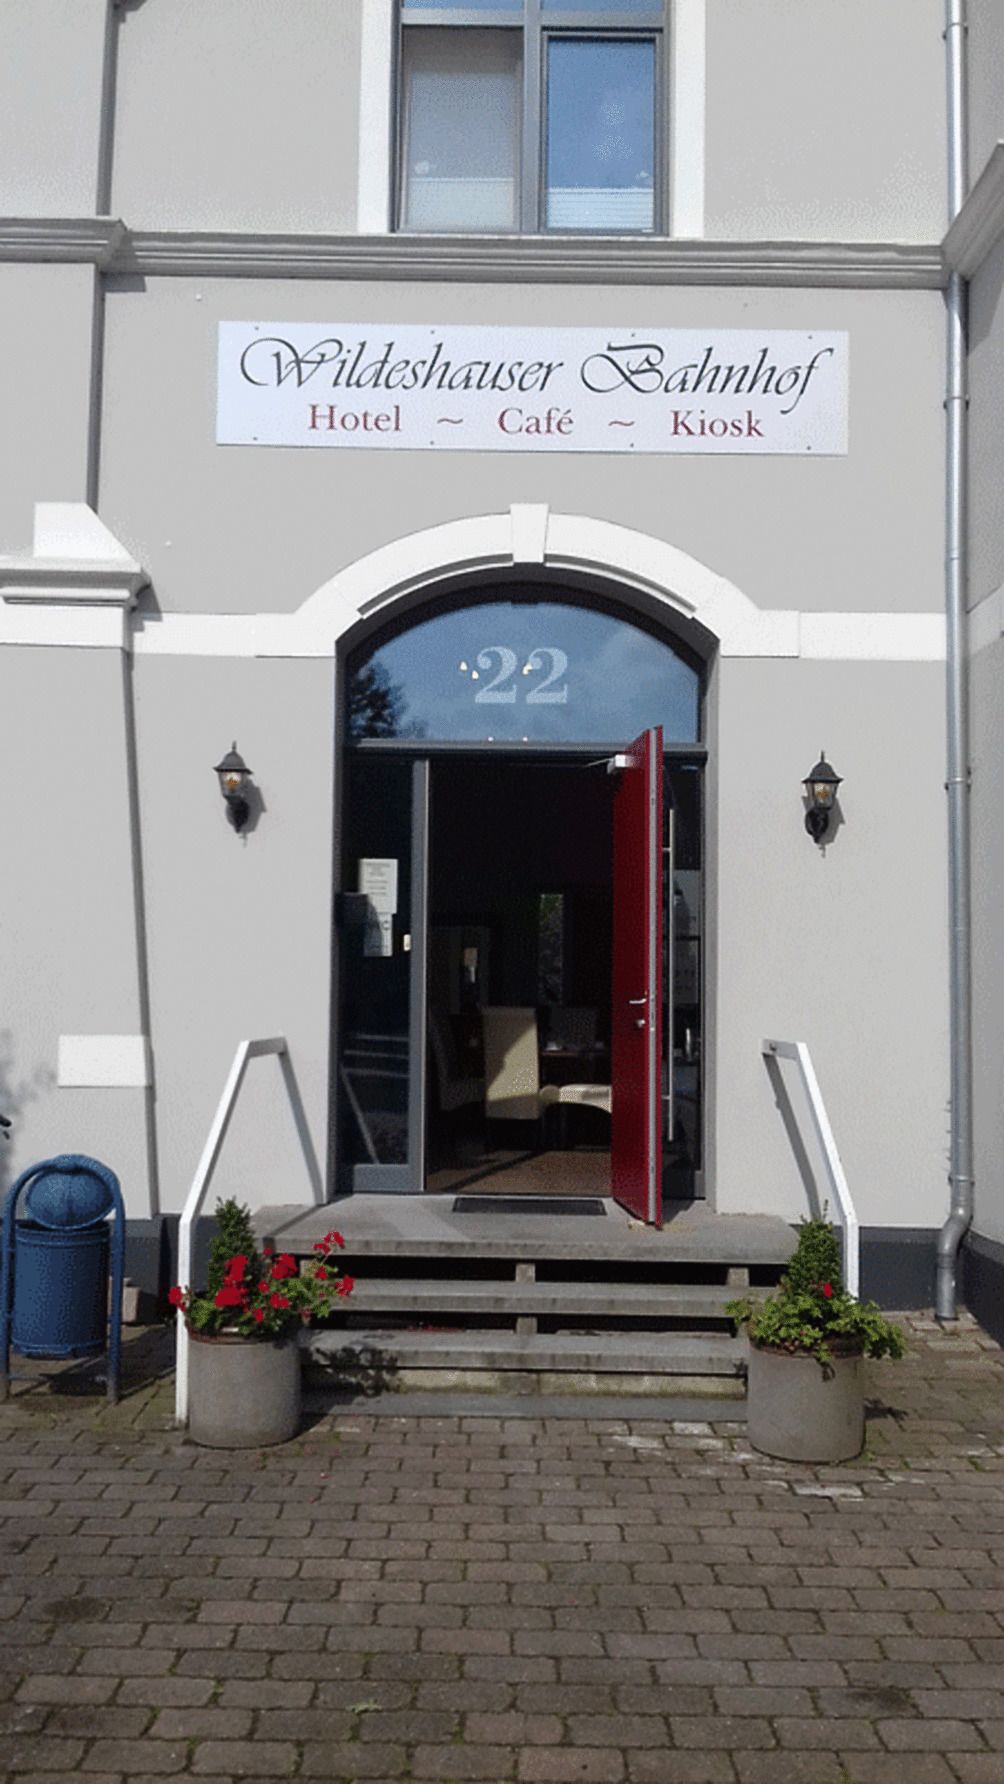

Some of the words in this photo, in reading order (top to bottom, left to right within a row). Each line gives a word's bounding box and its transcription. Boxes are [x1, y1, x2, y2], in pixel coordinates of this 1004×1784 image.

[240, 337, 564, 392] Wildeshauser
[580, 341, 835, 415] Bahnhof
[308, 403, 402, 433] Hotel
[497, 406, 575, 435] Café
[670, 409, 765, 438] Kiosk
[475, 646, 568, 704] 22
